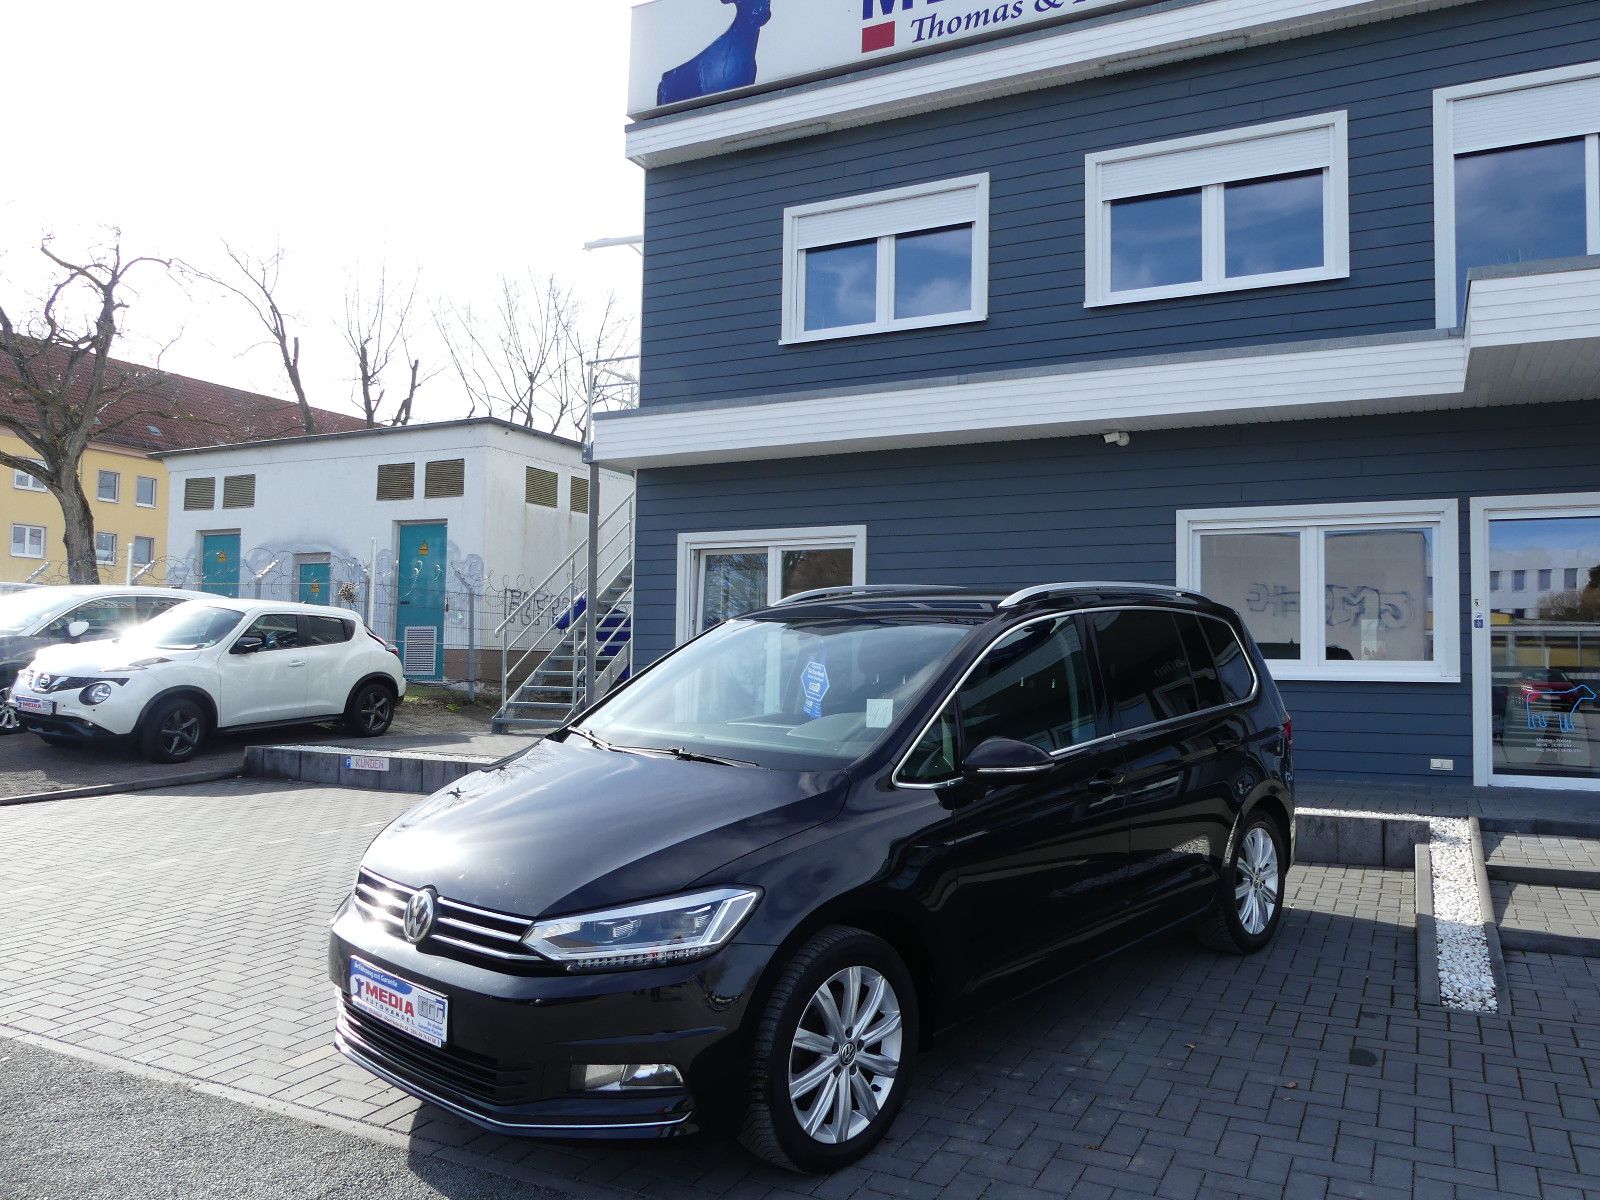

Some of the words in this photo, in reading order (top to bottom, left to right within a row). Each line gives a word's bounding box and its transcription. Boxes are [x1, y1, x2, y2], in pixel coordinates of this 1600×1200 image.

[910, 0, 1024, 43] Thomas
[355, 758, 384, 769] KUNDEN
[365, 980, 415, 1018] MEDIA
